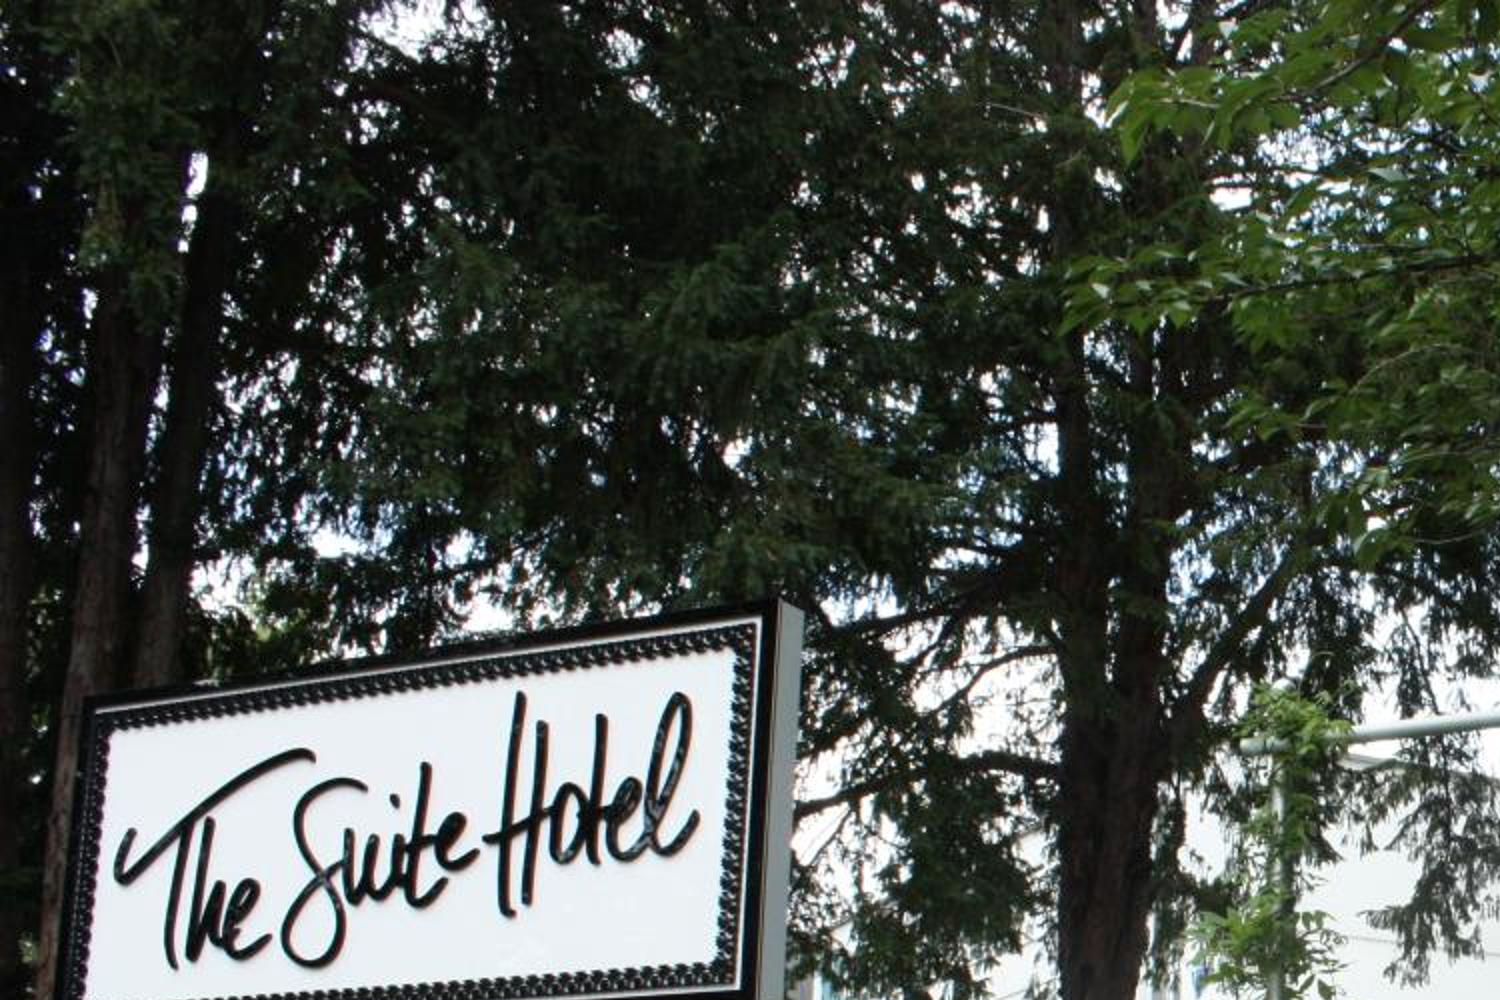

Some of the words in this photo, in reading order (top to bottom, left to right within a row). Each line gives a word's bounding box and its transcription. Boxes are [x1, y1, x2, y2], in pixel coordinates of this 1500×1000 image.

[114, 747, 317, 970] The
[281, 761, 480, 969] Suite
[481, 690, 700, 918] Hotel
